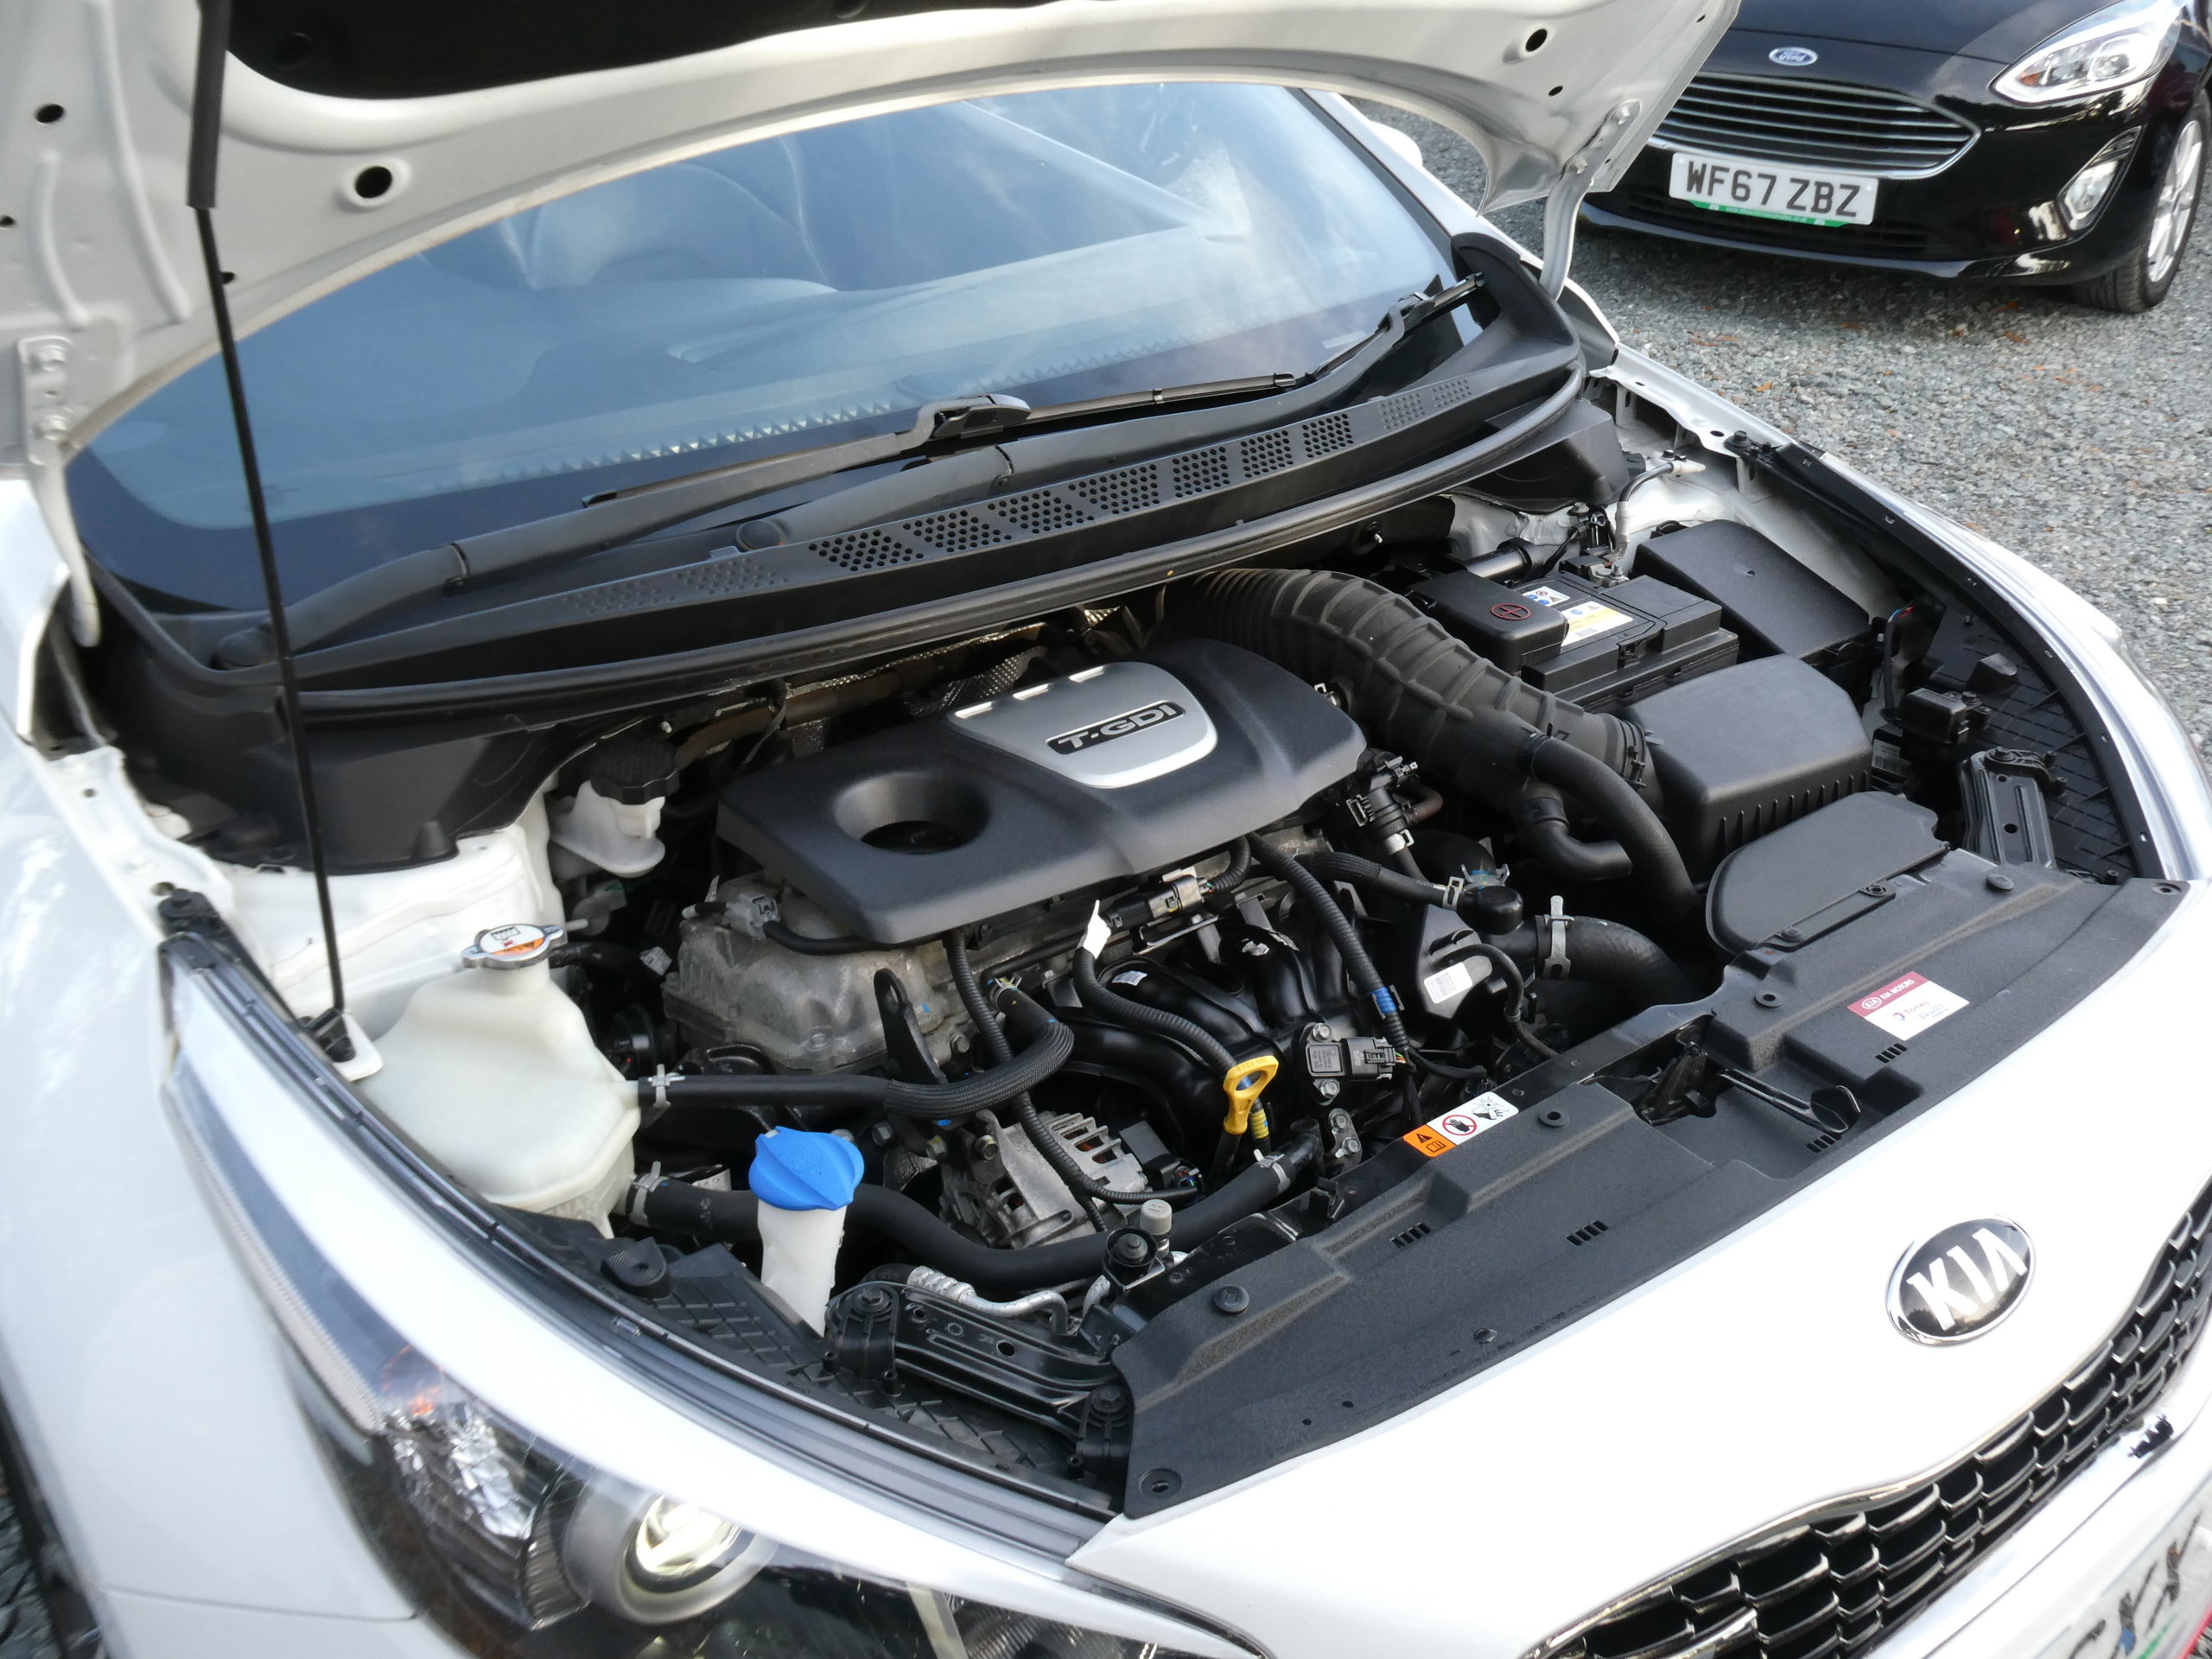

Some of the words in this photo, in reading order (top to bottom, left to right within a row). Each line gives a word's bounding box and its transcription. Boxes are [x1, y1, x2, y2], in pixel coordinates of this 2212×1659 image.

[1686, 160, 1777, 207] WF67
[1785, 177, 1861, 218] ZBZ
[1890, 979, 1916, 995] MOTORS
[1905, 1227, 2029, 1332] KIA
